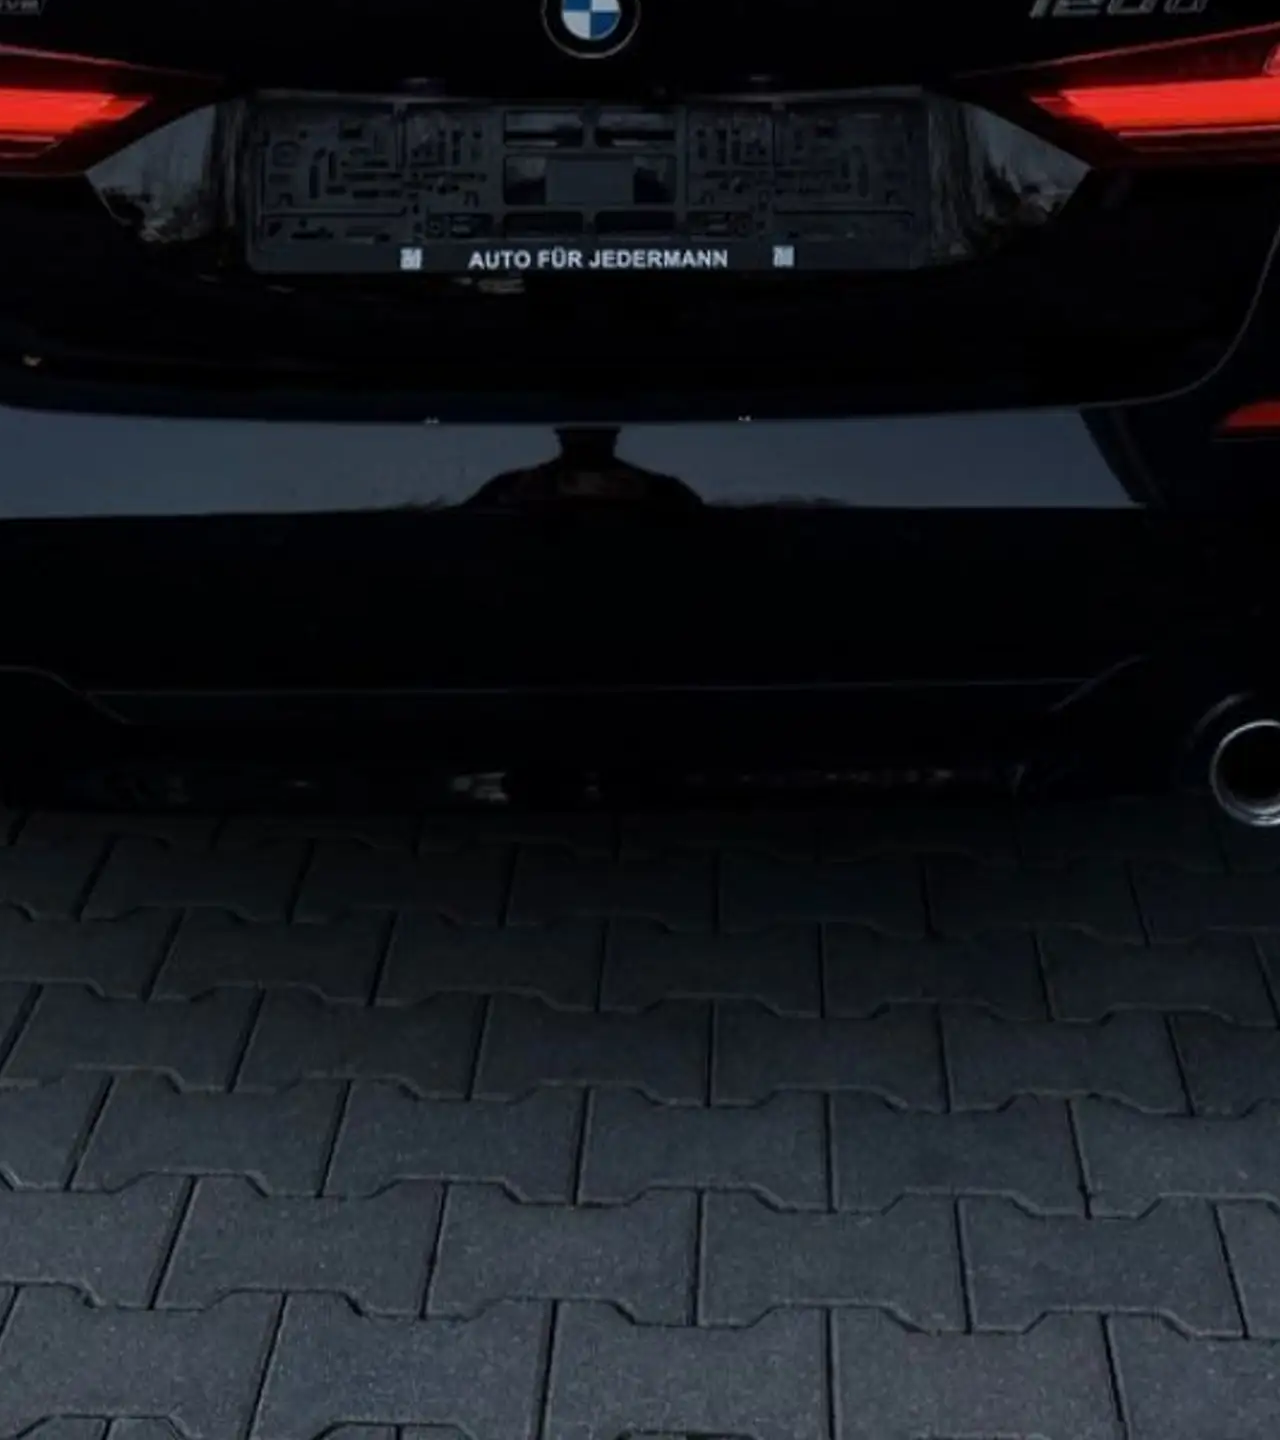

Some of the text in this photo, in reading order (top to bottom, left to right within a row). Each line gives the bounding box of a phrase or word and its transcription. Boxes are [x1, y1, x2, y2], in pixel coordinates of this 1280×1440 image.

[467, 245, 729, 271] AUTO FÜR JEDERMANN
